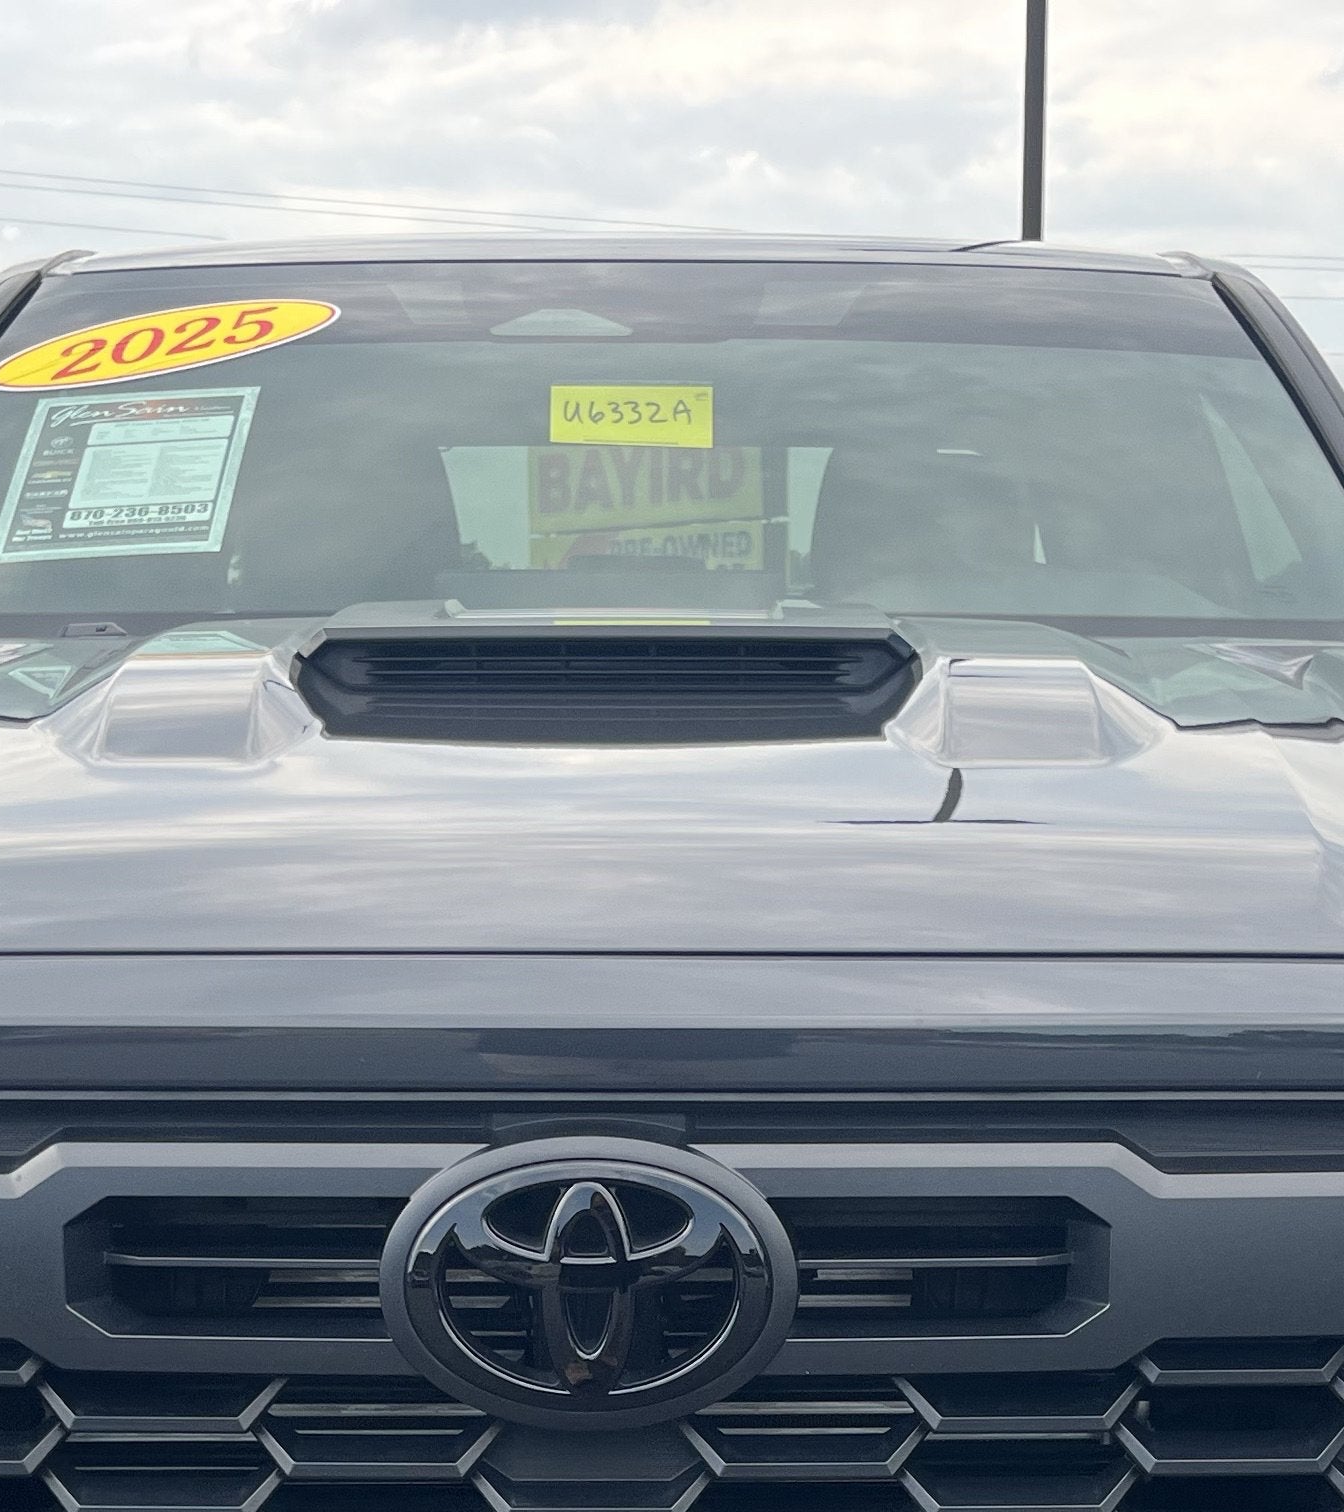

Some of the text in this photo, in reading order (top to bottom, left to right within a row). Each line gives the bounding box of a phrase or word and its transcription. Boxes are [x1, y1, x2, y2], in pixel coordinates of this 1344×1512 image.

[51, 306, 278, 380] 2025
[69, 503, 210, 521] 870-236-8503
[537, 447, 745, 514] BAYIRD
